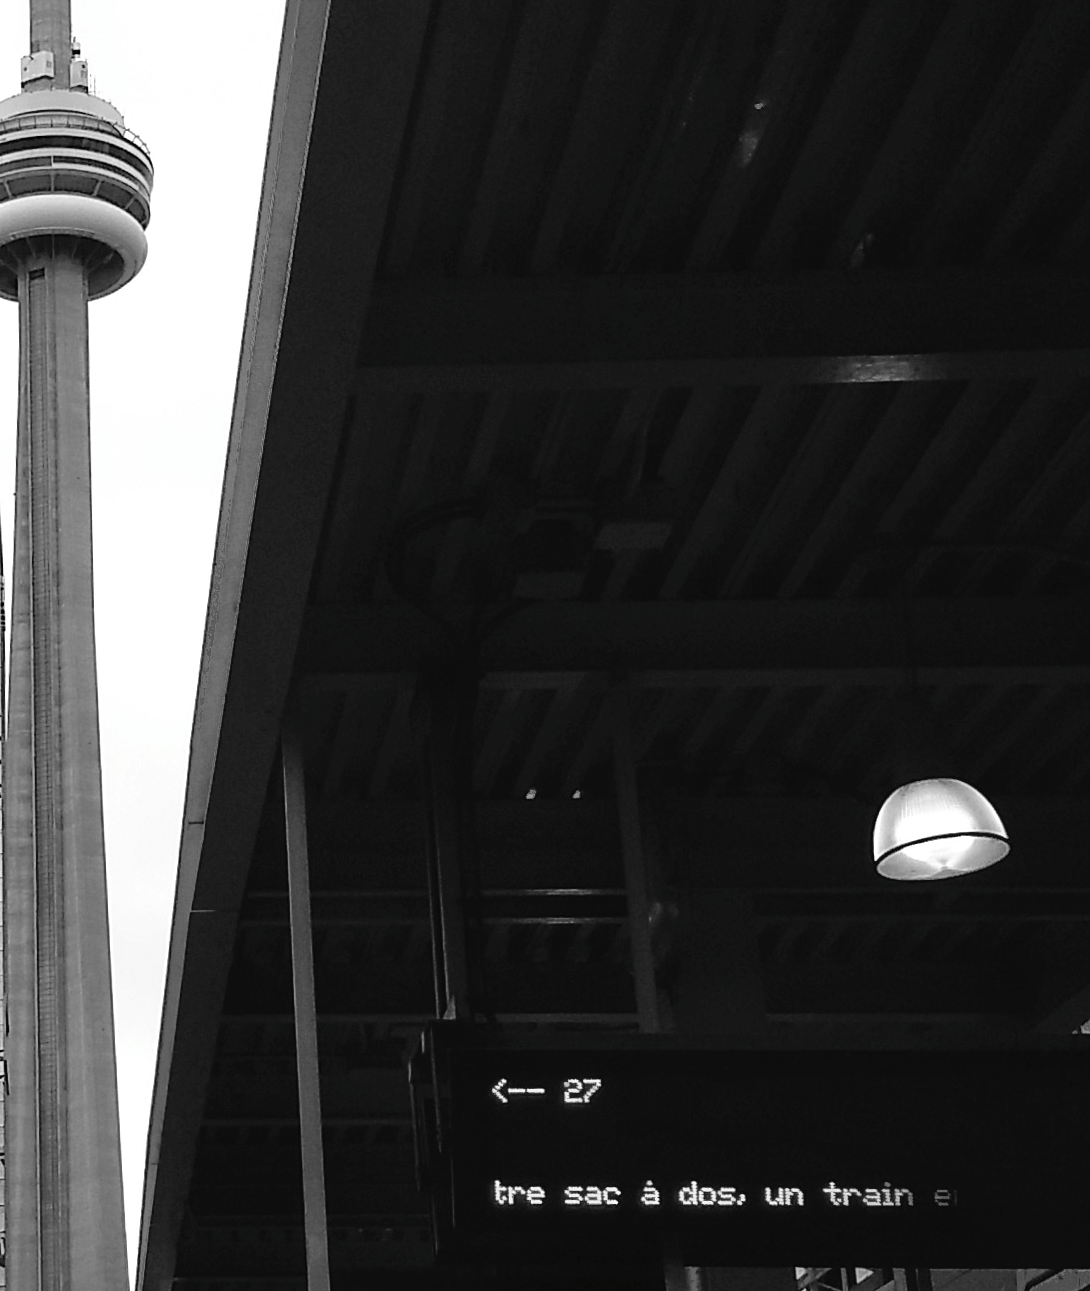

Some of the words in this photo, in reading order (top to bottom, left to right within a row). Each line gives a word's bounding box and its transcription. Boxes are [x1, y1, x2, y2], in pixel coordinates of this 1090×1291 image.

[563, 1077, 602, 1104] 27
[493, 1179, 546, 1206] tre
[563, 1185, 622, 1206] sac
[677, 1180, 747, 1206] dos,
[764, 1186, 805, 1207] un
[822, 1181, 914, 1207] train
